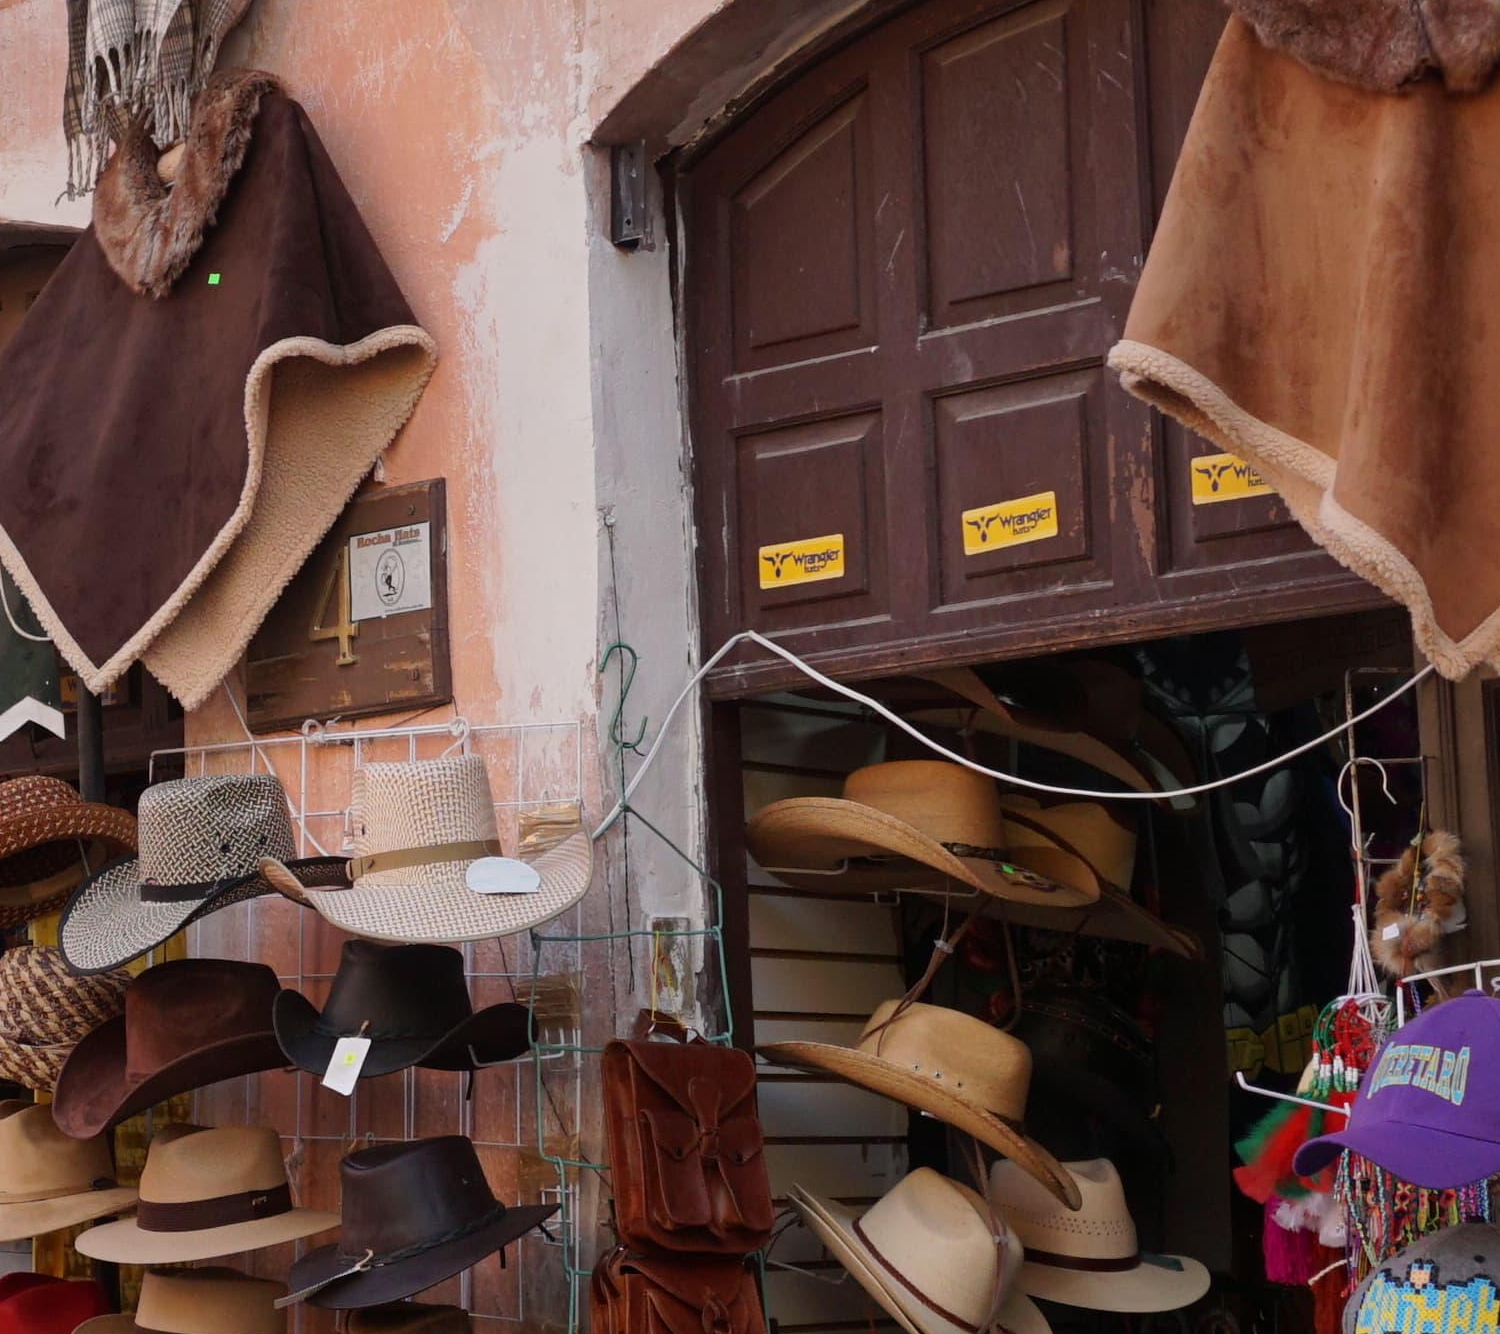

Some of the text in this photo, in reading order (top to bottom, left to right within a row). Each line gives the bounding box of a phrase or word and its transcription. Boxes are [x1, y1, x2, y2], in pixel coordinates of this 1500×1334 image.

[1000, 508, 1051, 533] Wrangler
[357, 534, 391, 548] Rocha
[394, 528, 420, 542] Hats
[793, 548, 840, 570] Wrangler
